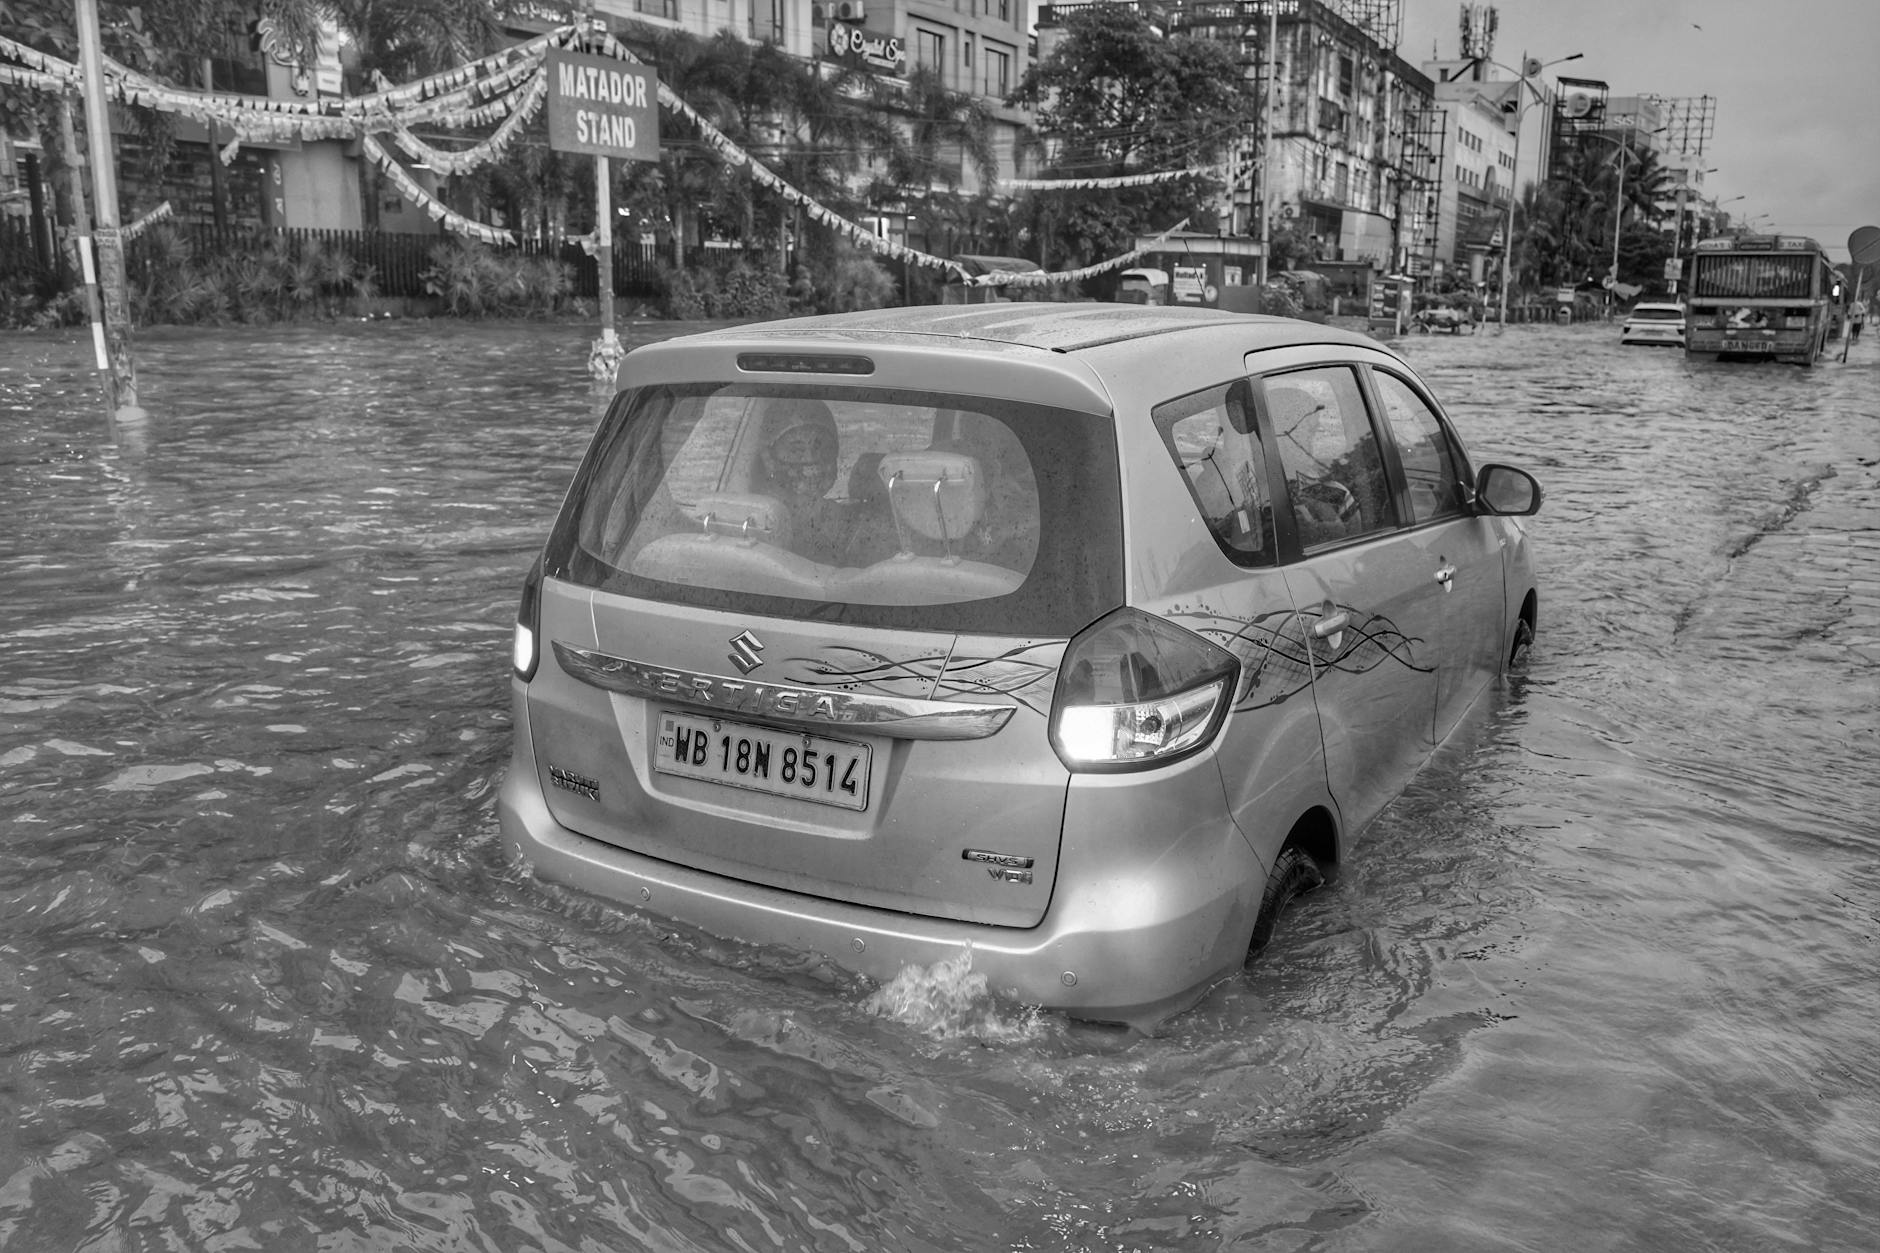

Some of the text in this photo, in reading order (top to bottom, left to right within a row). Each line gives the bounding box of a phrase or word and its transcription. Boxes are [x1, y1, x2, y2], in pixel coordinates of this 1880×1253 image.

[558, 62, 648, 108] MATADOR
[576, 109, 635, 148] STAND
[660, 672, 836, 720] ERTIGA
[659, 735, 675, 748] IND
[675, 726, 859, 795] WB 18N 8514
[976, 853, 1018, 866] SHVS
